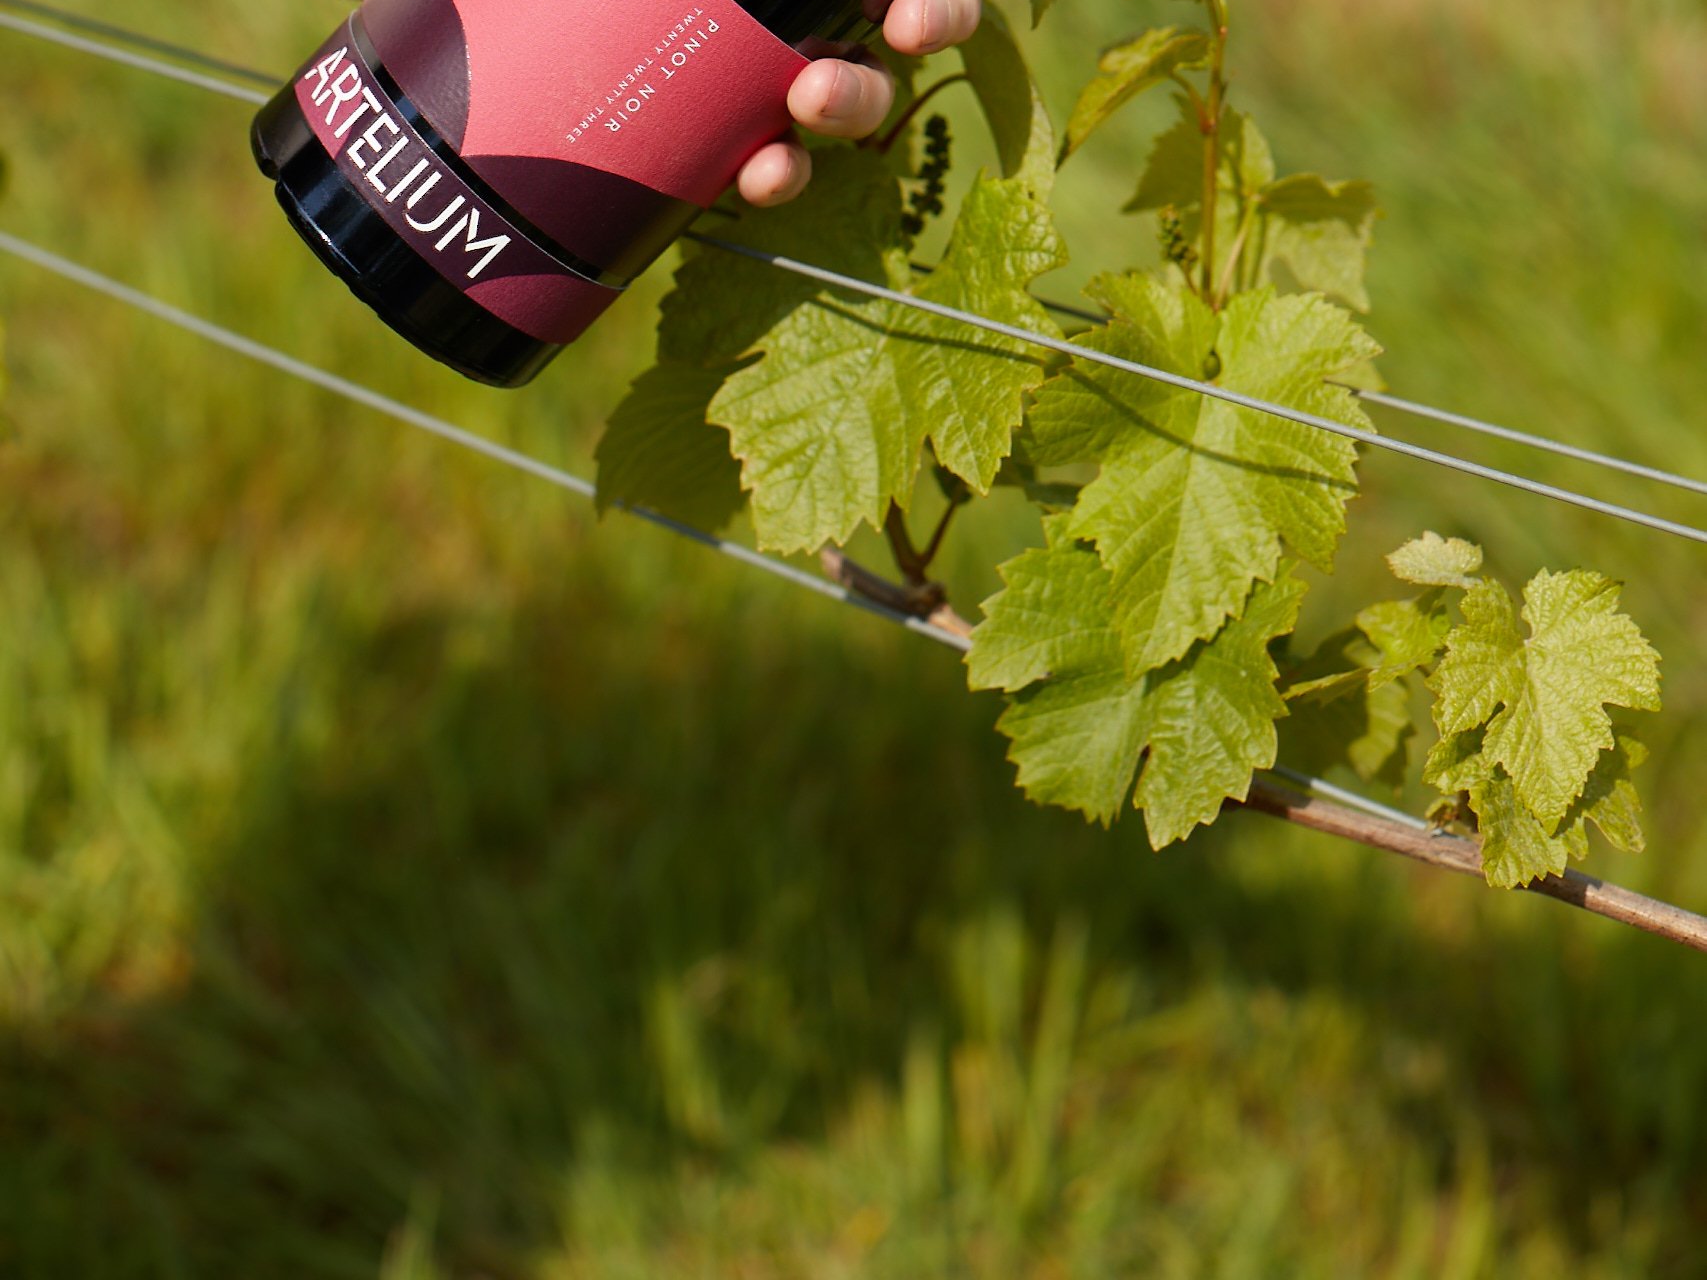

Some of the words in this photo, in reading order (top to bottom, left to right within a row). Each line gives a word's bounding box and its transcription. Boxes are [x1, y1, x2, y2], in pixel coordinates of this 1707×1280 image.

[654, 7, 704, 55] TWENTY
[660, 18, 720, 80] PINOT
[605, 57, 653, 104] TWENTY
[565, 106, 605, 144] THREE
[604, 83, 656, 132] NOIR
[304, 46, 512, 279] ARTELIUM
